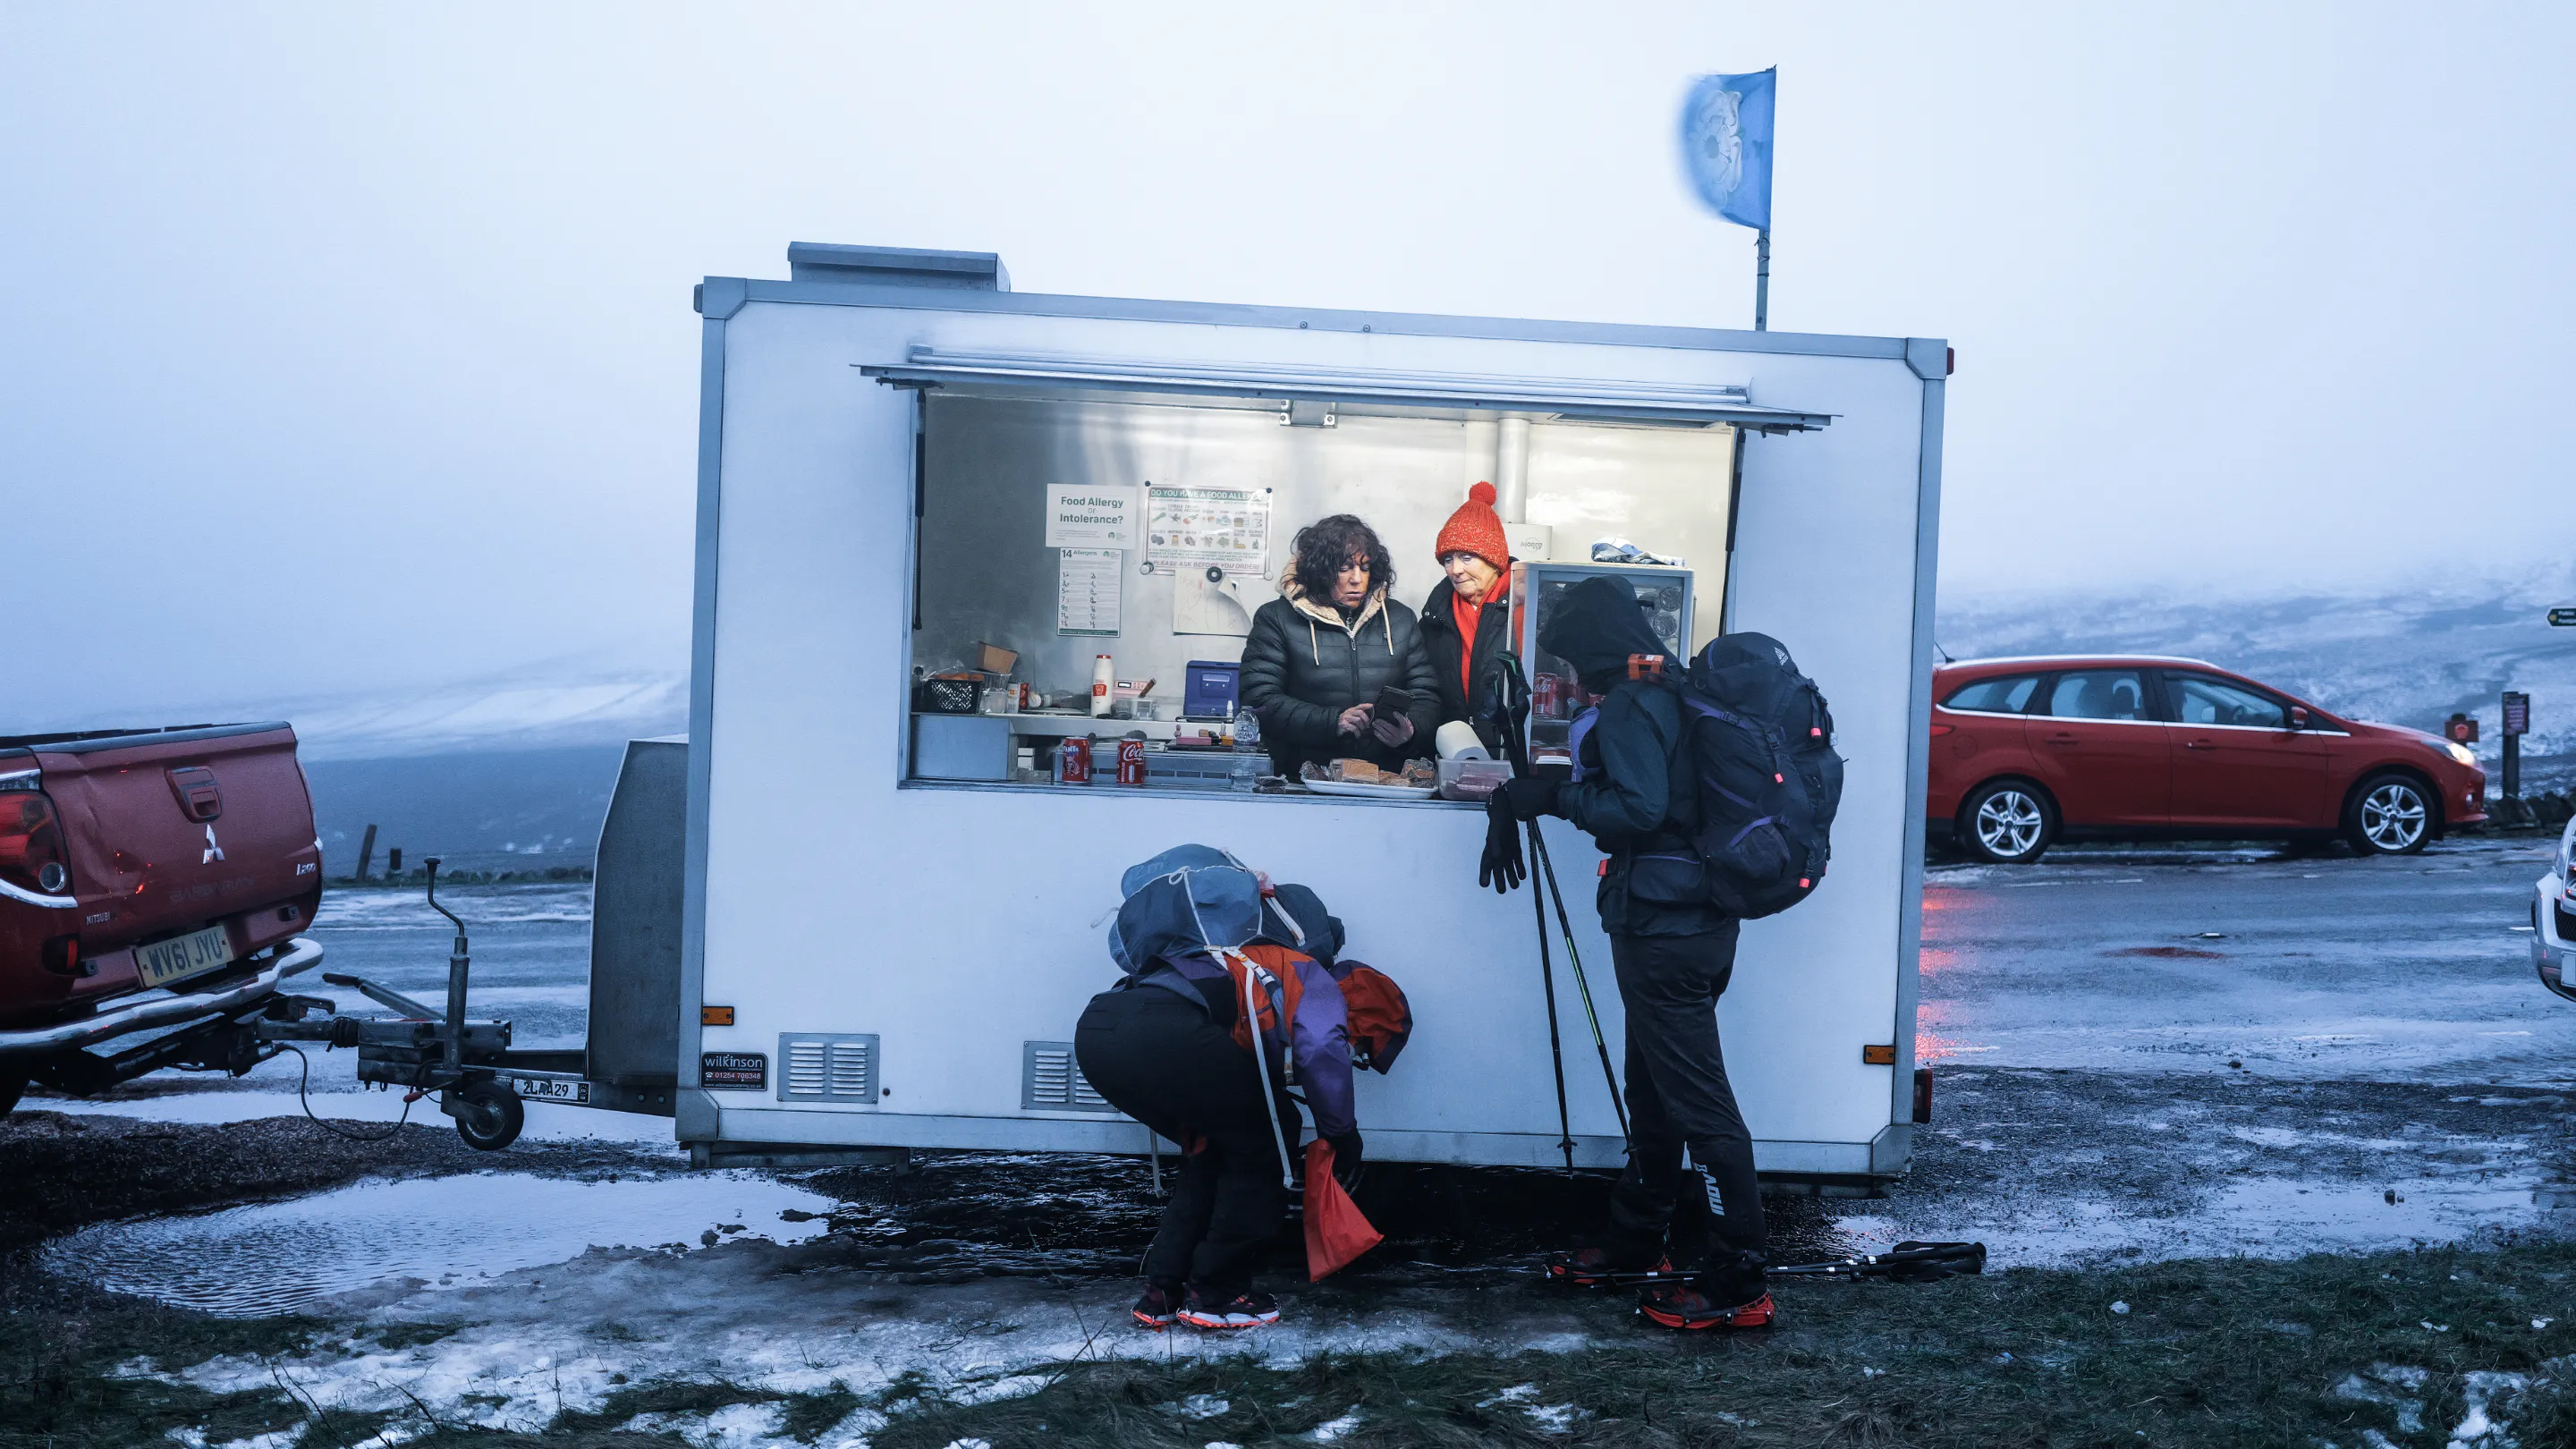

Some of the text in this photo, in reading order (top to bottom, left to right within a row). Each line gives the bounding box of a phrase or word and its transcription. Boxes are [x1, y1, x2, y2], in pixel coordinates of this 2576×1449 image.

[1151, 488, 1161, 496] DO
[1163, 489, 1178, 497] YOU
[1180, 489, 1199, 498] HAVE
[1208, 491, 1228, 499] FOOD
[1061, 496, 1123, 509] Food Allergy
[1060, 513, 1123, 524] Intolerance?
[1062, 549, 1072, 558] 14
[296, 862, 316, 877] L200
[86, 911, 111, 926] MITSUBI
[147, 931, 224, 979] WV61 JYU
[705, 1054, 763, 1068] wilkinson
